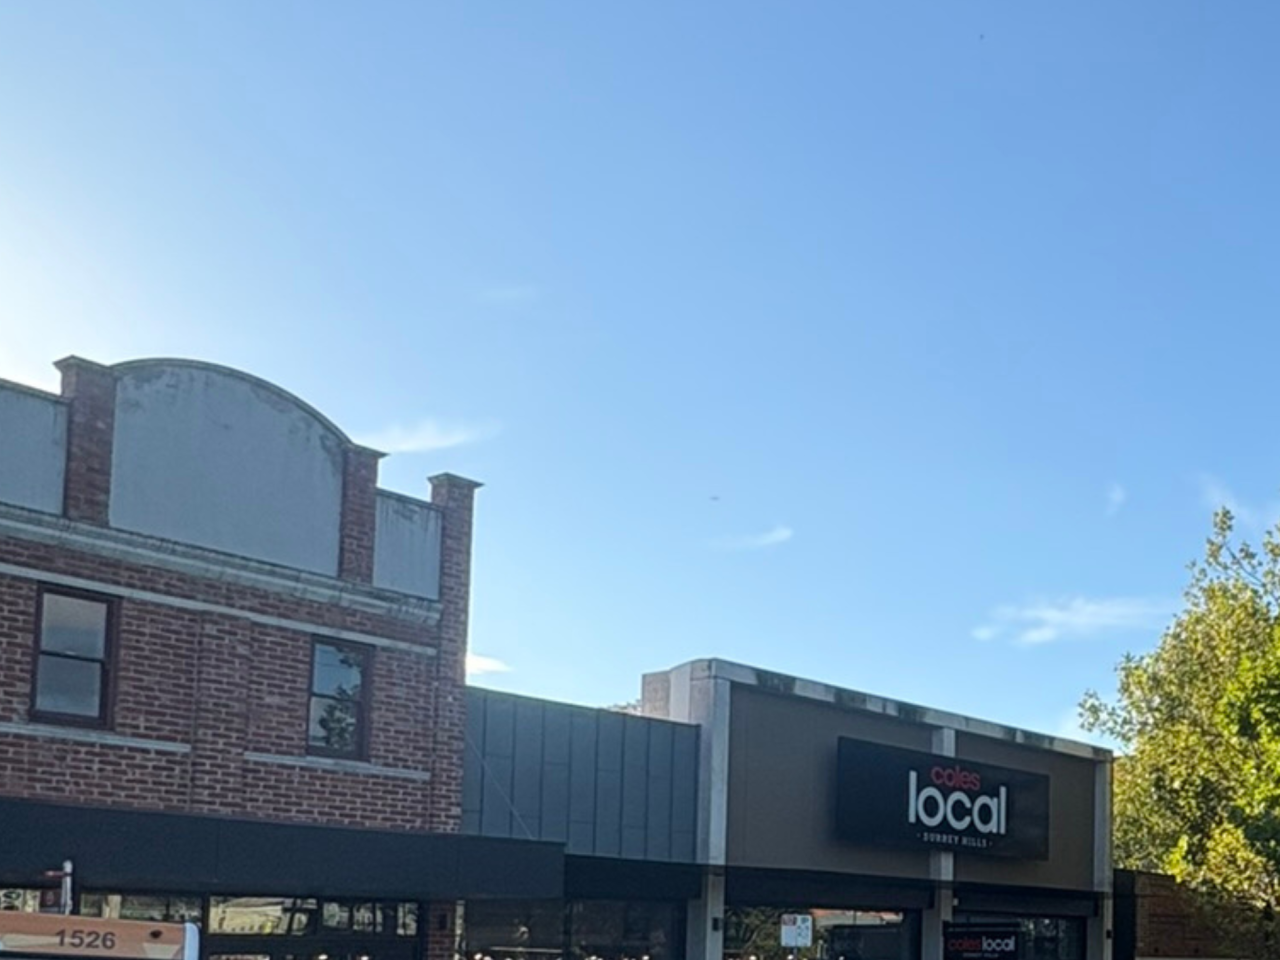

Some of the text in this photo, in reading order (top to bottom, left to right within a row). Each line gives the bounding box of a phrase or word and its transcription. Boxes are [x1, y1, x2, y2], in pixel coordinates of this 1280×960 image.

[930, 766, 981, 791] coles
[908, 769, 1007, 835] local
[56, 929, 116, 950] 1526
[982, 935, 1016, 952] local
